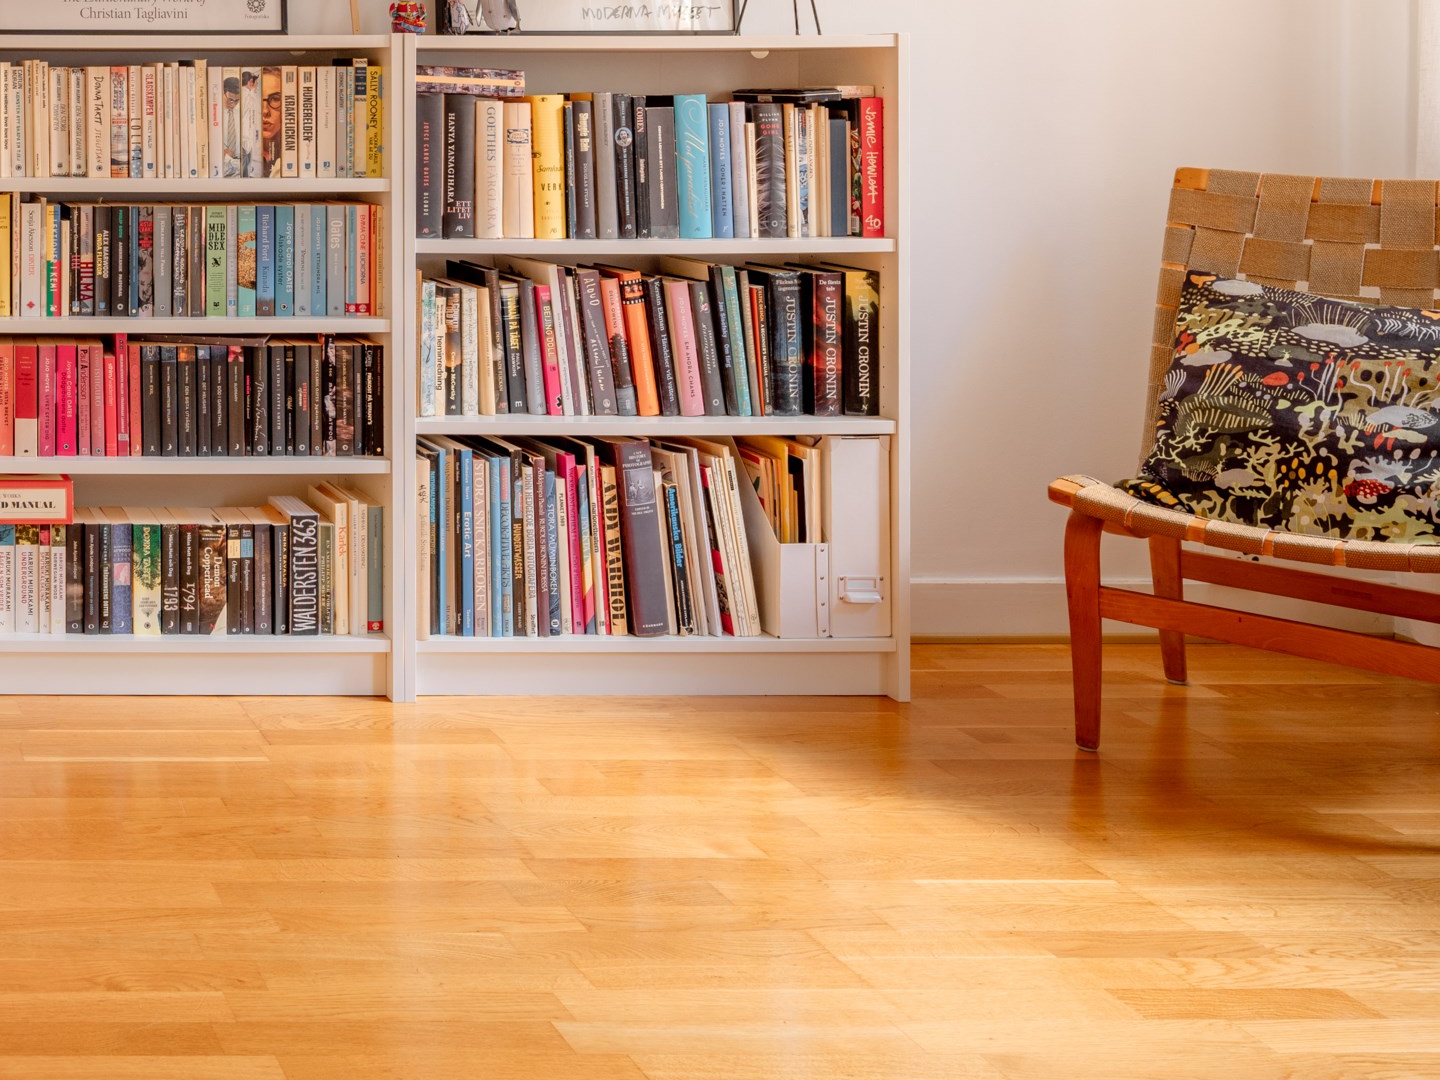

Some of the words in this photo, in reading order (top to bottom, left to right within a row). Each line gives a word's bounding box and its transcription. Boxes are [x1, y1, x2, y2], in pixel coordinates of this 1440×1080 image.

[79, 6, 131, 19] Christian
[134, 6, 188, 22] Tagliavini
[94, 76, 104, 101] DONNA
[369, 71, 378, 93] SALLY
[303, 86, 314, 142] HUNGERELDEN
[369, 94, 378, 129] ROONEY
[635, 106, 644, 133] COHEN
[130, 117, 142, 161] LOLITA
[447, 112, 455, 143] HANYA
[486, 106, 497, 161] GOETHES
[717, 118, 725, 136] JOJO
[718, 137, 726, 160] MOYES
[447, 145, 455, 204] YANAGIHARA
[27, 210, 35, 228] Sonja
[208, 222, 226, 232] MID
[261, 213, 270, 243] Richard
[285, 221, 293, 245] Joyce
[330, 219, 343, 249] Oates
[865, 214, 882, 228] 40
[208, 232, 226, 241] DLE
[208, 241, 225, 251] SEX
[261, 244, 270, 262] Ford
[50, 272, 58, 292] KEMI
[80, 261, 94, 301] HILMA
[261, 265, 270, 294] Kanada
[277, 265, 285, 286] syster
[285, 270, 293, 294] OATES
[509, 321, 519, 330] PÅ
[543, 305, 553, 336] BEIJING
[785, 295, 797, 343] JUSTIN
[825, 296, 836, 344] JUSTIN
[858, 295, 869, 343] JUSTIN
[509, 331, 520, 350] TÅGET
[546, 337, 555, 357] DOLL
[653, 281, 661, 307] Kerstin
[657, 307, 665, 331] Ekman
[667, 381, 676, 402] vatten
[724, 343, 730, 354] Om
[80, 349, 88, 364] Paul
[435, 335, 445, 391] heminredning
[858, 345, 870, 398] CRONIN
[80, 364, 88, 400] Andersson
[94, 367, 102, 407] ISHIGURO
[788, 346, 799, 398] CRONIN
[826, 347, 837, 399] CRONIN
[473, 463, 485, 505] STORA
[524, 472, 532, 491] JOHN
[10, 501, 56, 509] MANUAL
[525, 491, 533, 527] HEDGECOE
[547, 503, 555, 532] STORA
[603, 480, 622, 533] ANDY
[142, 526, 151, 556] DONNA
[292, 516, 318, 547] 365
[463, 511, 472, 541] Erotic
[500, 501, 511, 562] DECORATIVE
[539, 518, 547, 545] RUKOUS
[591, 502, 600, 554] marionetteatern
[667, 487, 681, 542] Amerikanska
[674, 543, 685, 568] Bilder
[463, 541, 472, 559] Art
[474, 510, 486, 612] SNICKARBOKEN
[512, 523, 523, 580] HUNDERTWASSER
[549, 533, 558, 596] MUMINBOKEN
[202, 546, 213, 599] Copperhead
[213, 556, 223, 587] Demon
[501, 563, 511, 589] ARTS
[528, 551, 536, 599] FOTOGRAFERA
[607, 536, 626, 626] WARHOL
[163, 586, 178, 611] 1793
[181, 582, 196, 612] 1794
[292, 546, 318, 632] WALDERSTEN
